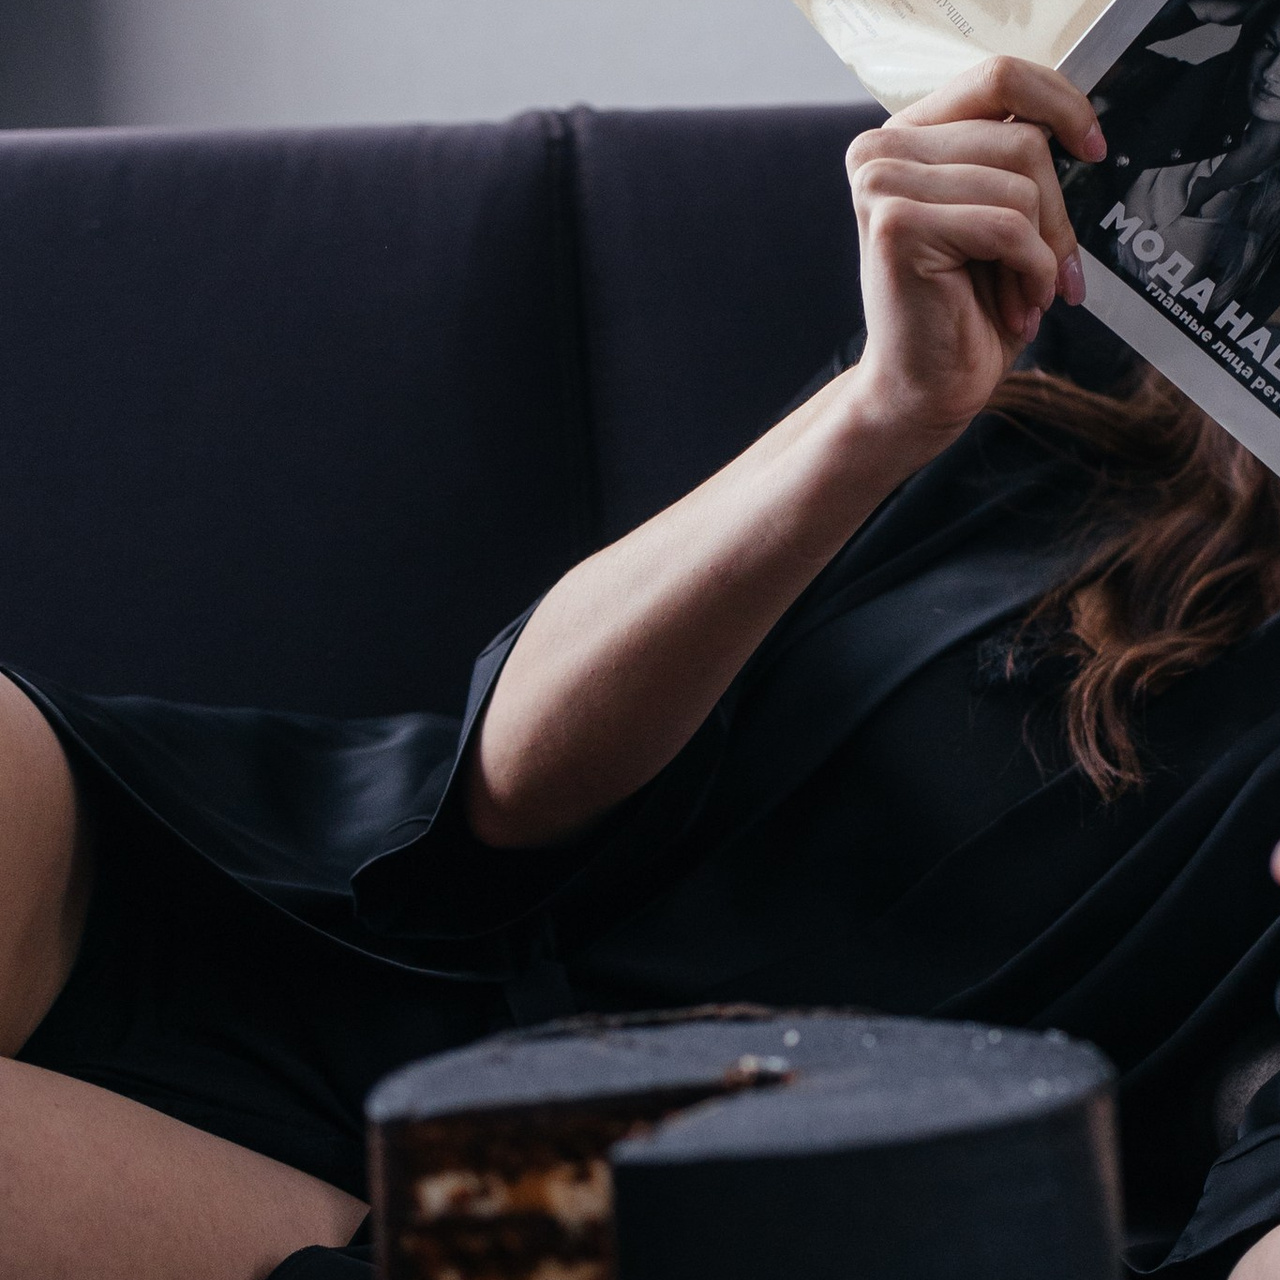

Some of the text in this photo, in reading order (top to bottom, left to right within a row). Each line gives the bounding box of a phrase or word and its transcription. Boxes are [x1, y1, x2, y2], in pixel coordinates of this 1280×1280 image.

[1100, 201, 1216, 313] МОДА
[1145, 282, 1213, 342] главные
[1212, 339, 1254, 379] лица
